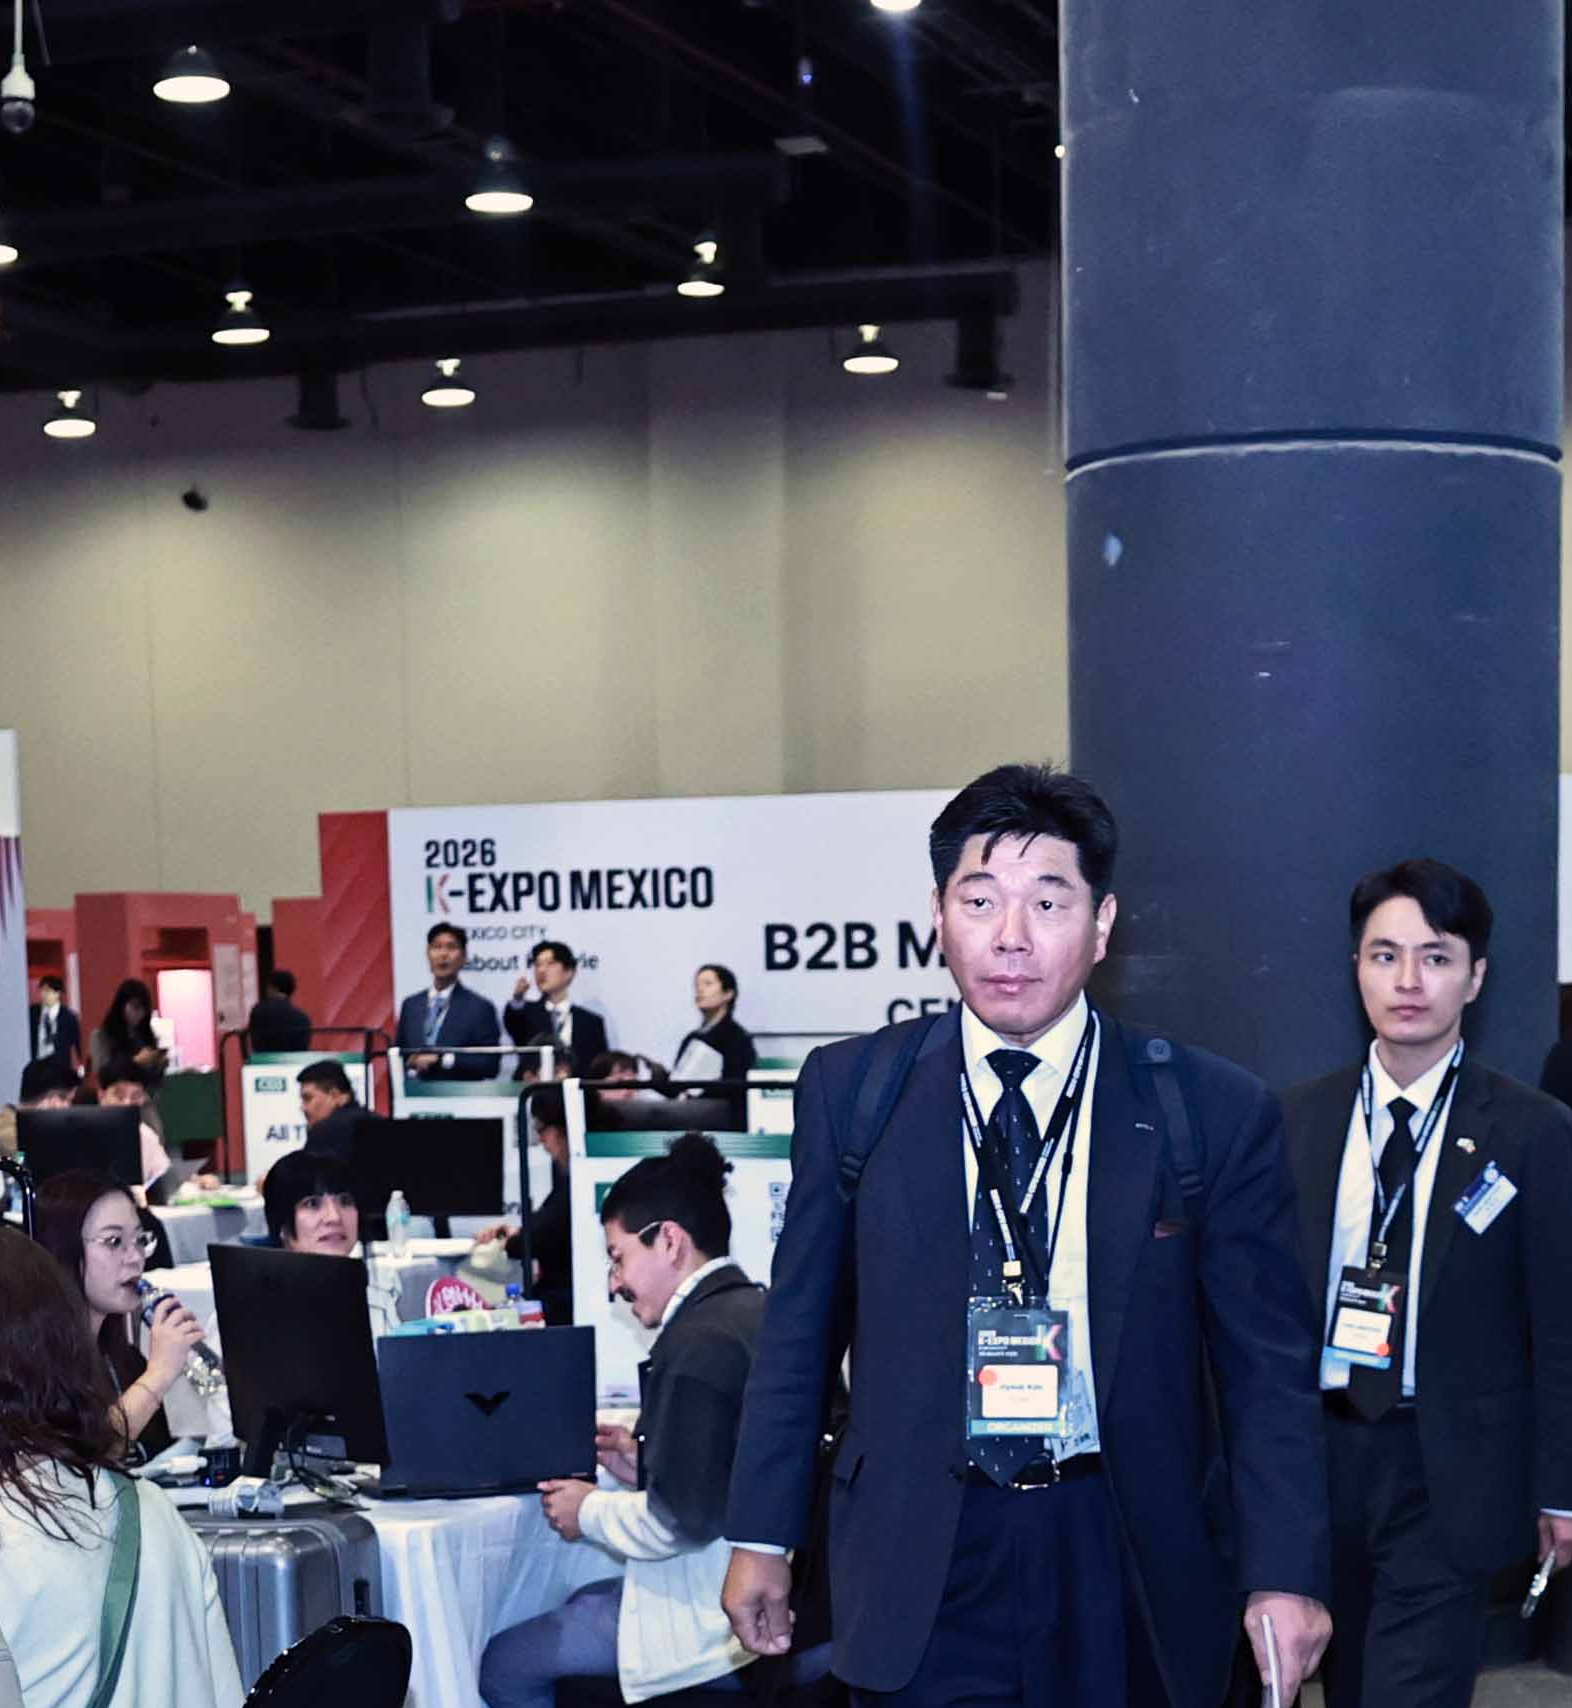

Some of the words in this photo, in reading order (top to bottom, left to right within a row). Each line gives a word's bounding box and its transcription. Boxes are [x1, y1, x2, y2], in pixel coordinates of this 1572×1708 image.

[425, 839, 496, 868] 2026
[426, 871, 560, 913] K-EXPO
[570, 867, 714, 910] MEXICO
[466, 927, 507, 941] XICO
[765, 922, 878, 971] B2B
